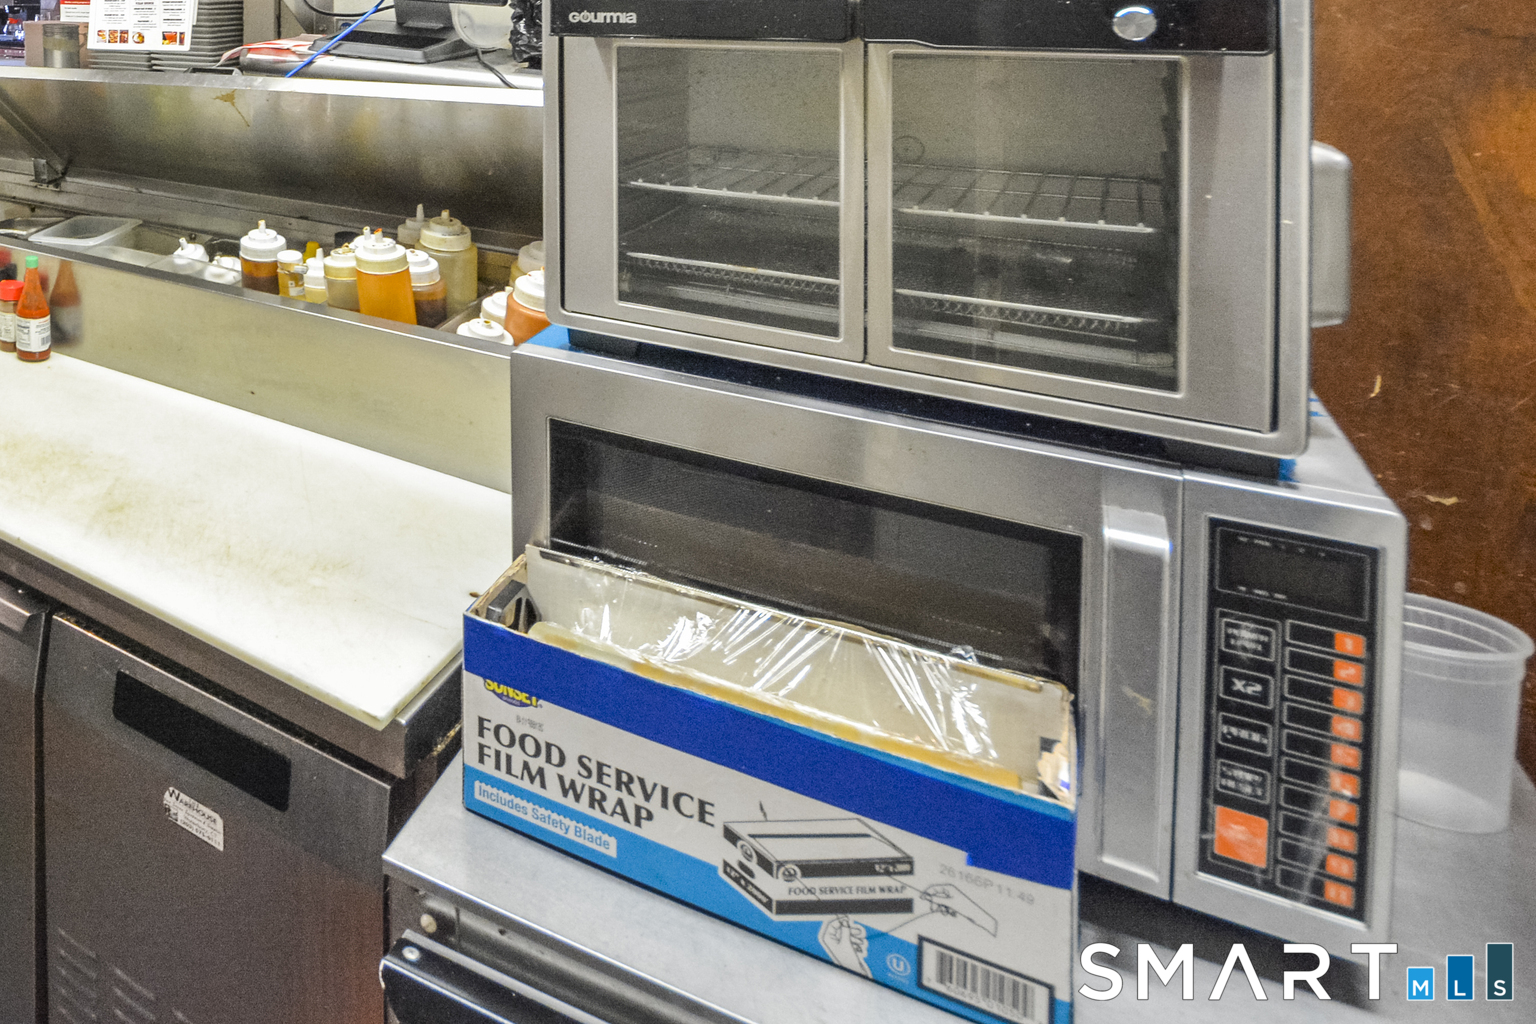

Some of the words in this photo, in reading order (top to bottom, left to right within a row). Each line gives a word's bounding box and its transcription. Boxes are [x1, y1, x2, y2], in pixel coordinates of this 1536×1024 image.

[1230, 677, 1263, 697] X2
[477, 715, 566, 768] FOOD
[577, 754, 716, 827] SERVICE
[477, 742, 547, 790] FILM
[556, 773, 654, 829] WRAP
[478, 784, 528, 815] Includes
[531, 807, 571, 836] Safety
[574, 824, 611, 851] Blade
[787, 886, 817, 896] FOOD
[818, 885, 854, 895] SERVICE
[856, 885, 876, 894] FILM
[878, 884, 907, 894] WRAP
